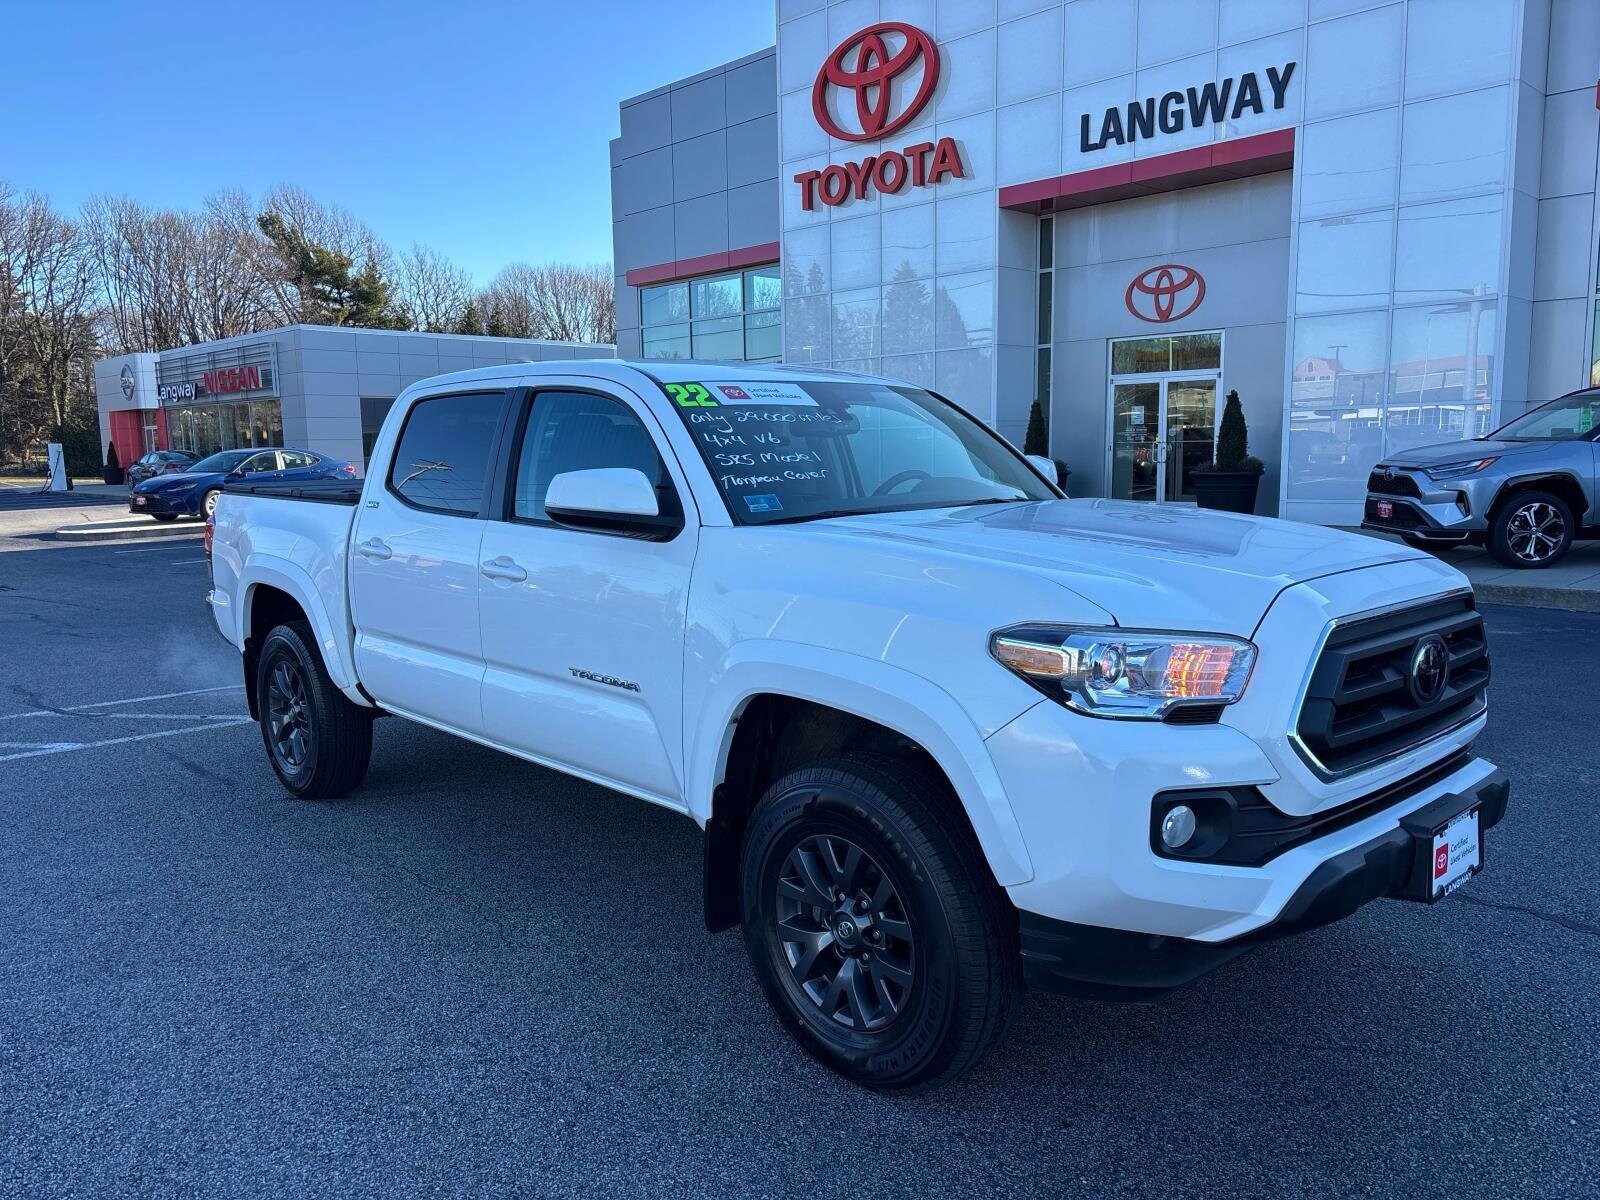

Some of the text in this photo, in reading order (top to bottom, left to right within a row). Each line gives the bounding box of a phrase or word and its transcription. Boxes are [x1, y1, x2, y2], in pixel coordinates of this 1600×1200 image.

[1080, 62, 1295, 153] LANGWAY
[794, 137, 967, 211] TOYOTA
[157, 382, 197, 401] Langway
[203, 366, 261, 394] NISSAN
[665, 384, 719, 407] 22
[568, 666, 641, 693] TACOMA
[1450, 835, 1469, 853] Certified
